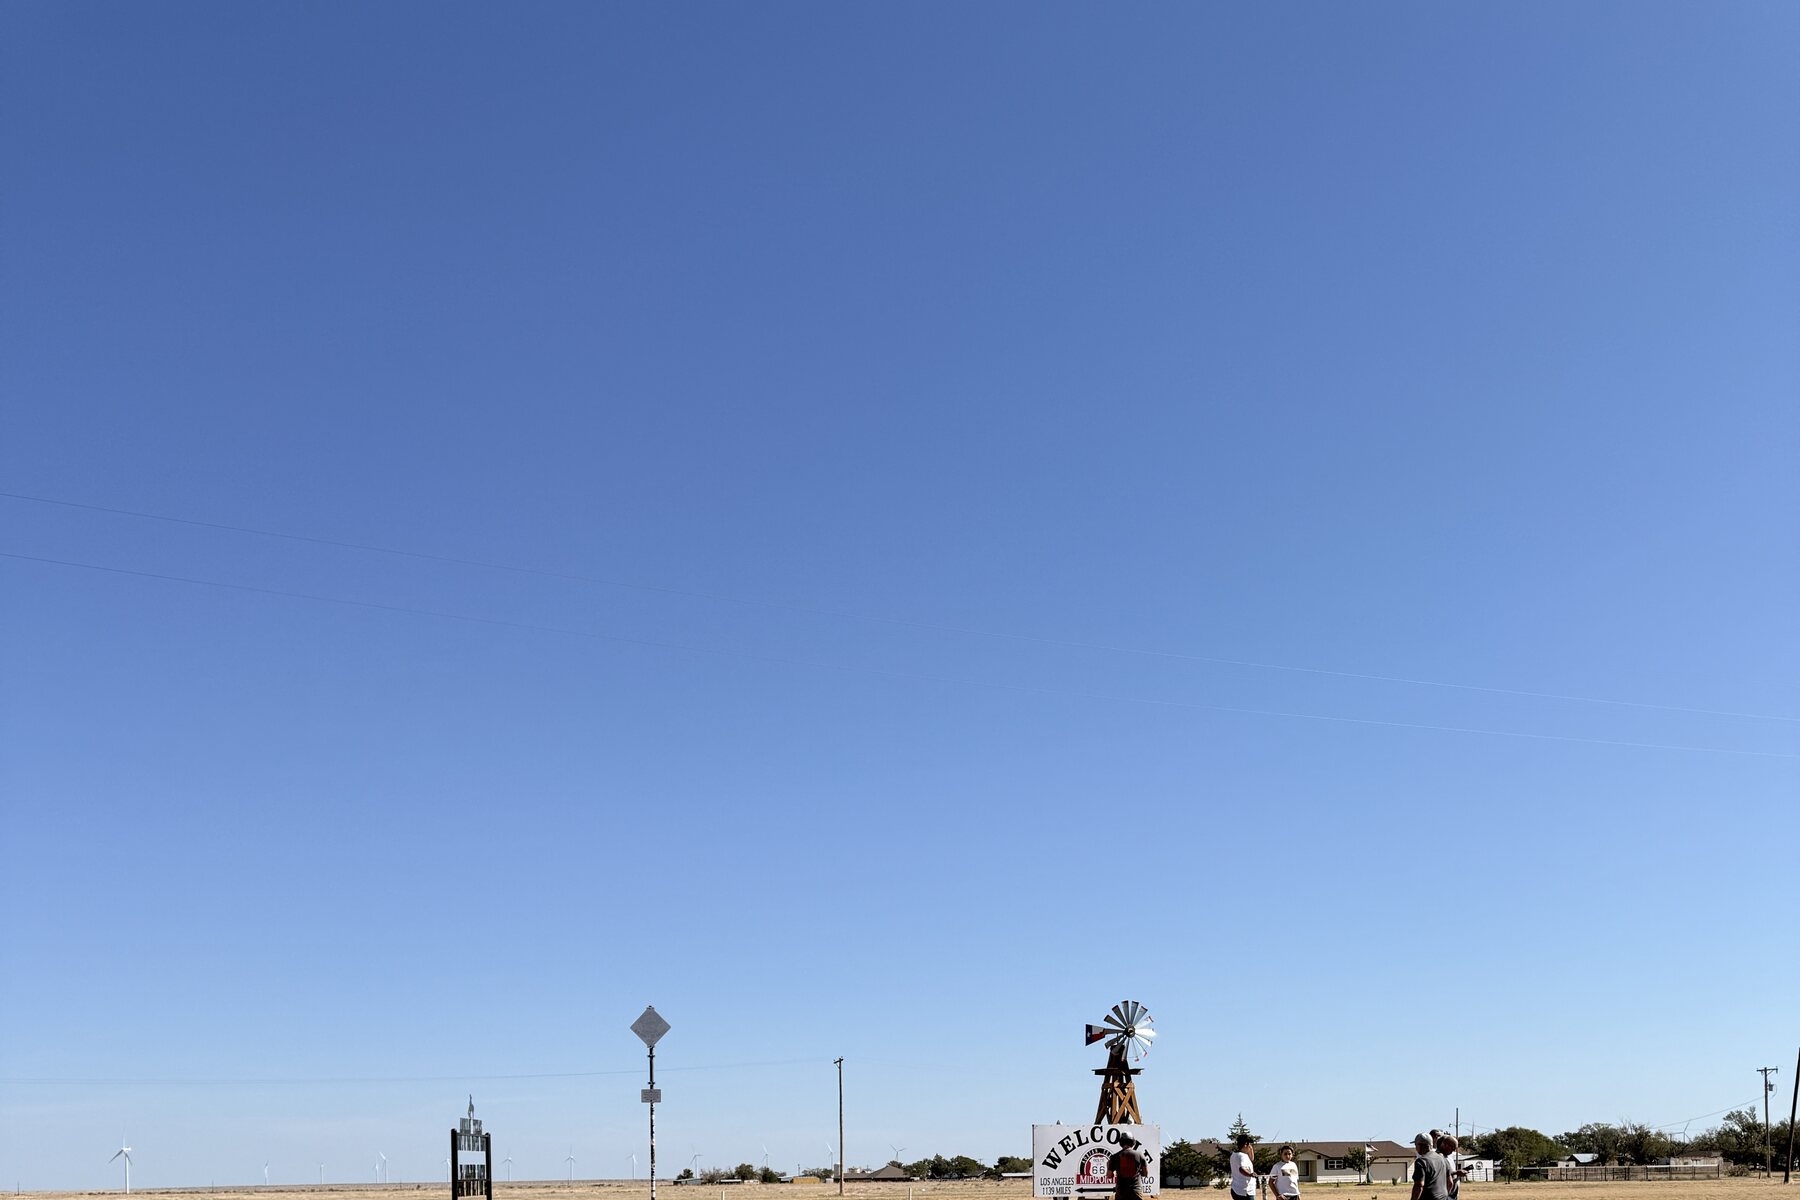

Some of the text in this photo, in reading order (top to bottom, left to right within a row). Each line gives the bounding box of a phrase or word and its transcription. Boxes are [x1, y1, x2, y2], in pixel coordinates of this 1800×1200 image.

[1042, 1125, 1153, 1170] WELCOE
[1092, 1165, 1106, 1175] 66
[1040, 1177, 1075, 1186] LOS ANGELES
[1042, 1186, 1072, 1195] 1139 MILES
